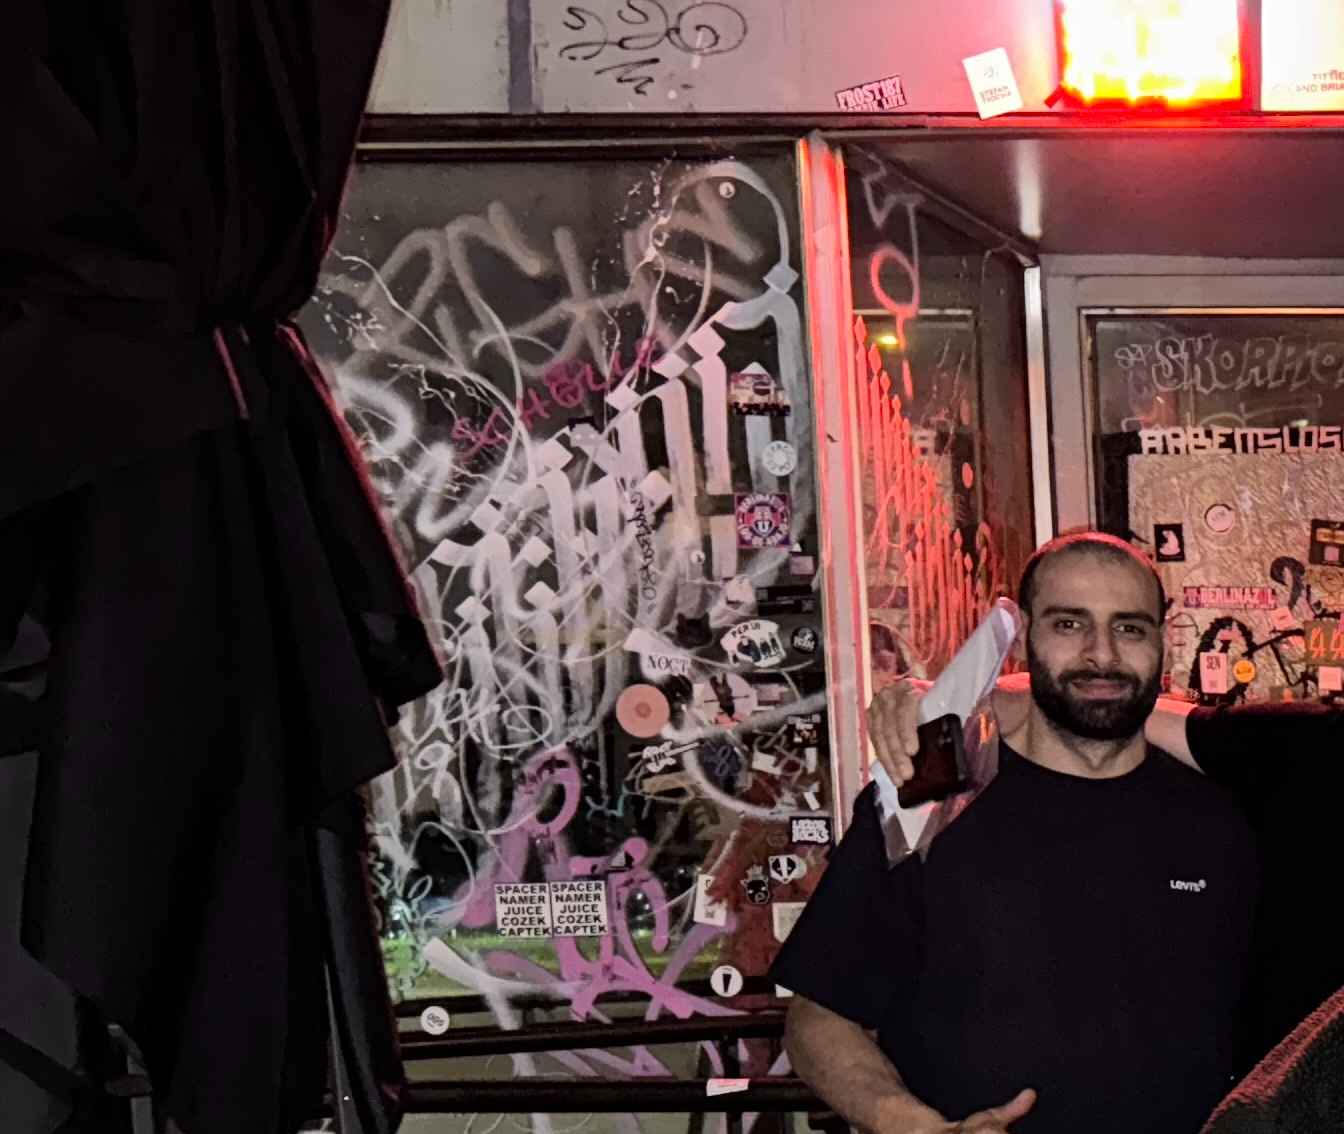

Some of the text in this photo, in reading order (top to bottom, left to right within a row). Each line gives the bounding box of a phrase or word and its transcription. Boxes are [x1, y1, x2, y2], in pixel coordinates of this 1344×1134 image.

[496, 885, 547, 895] SPACER
[551, 881, 603, 893] SPACER
[500, 895, 546, 905] NAMER
[555, 893, 602, 903] NAMER
[504, 906, 544, 916] JUICE
[560, 904, 599, 914] JUICE
[501, 916, 546, 927] COZEK
[557, 915, 602, 925] COZEK
[496, 927, 552, 937] CAPTEK
[553, 925, 608, 935] CAPTEK
